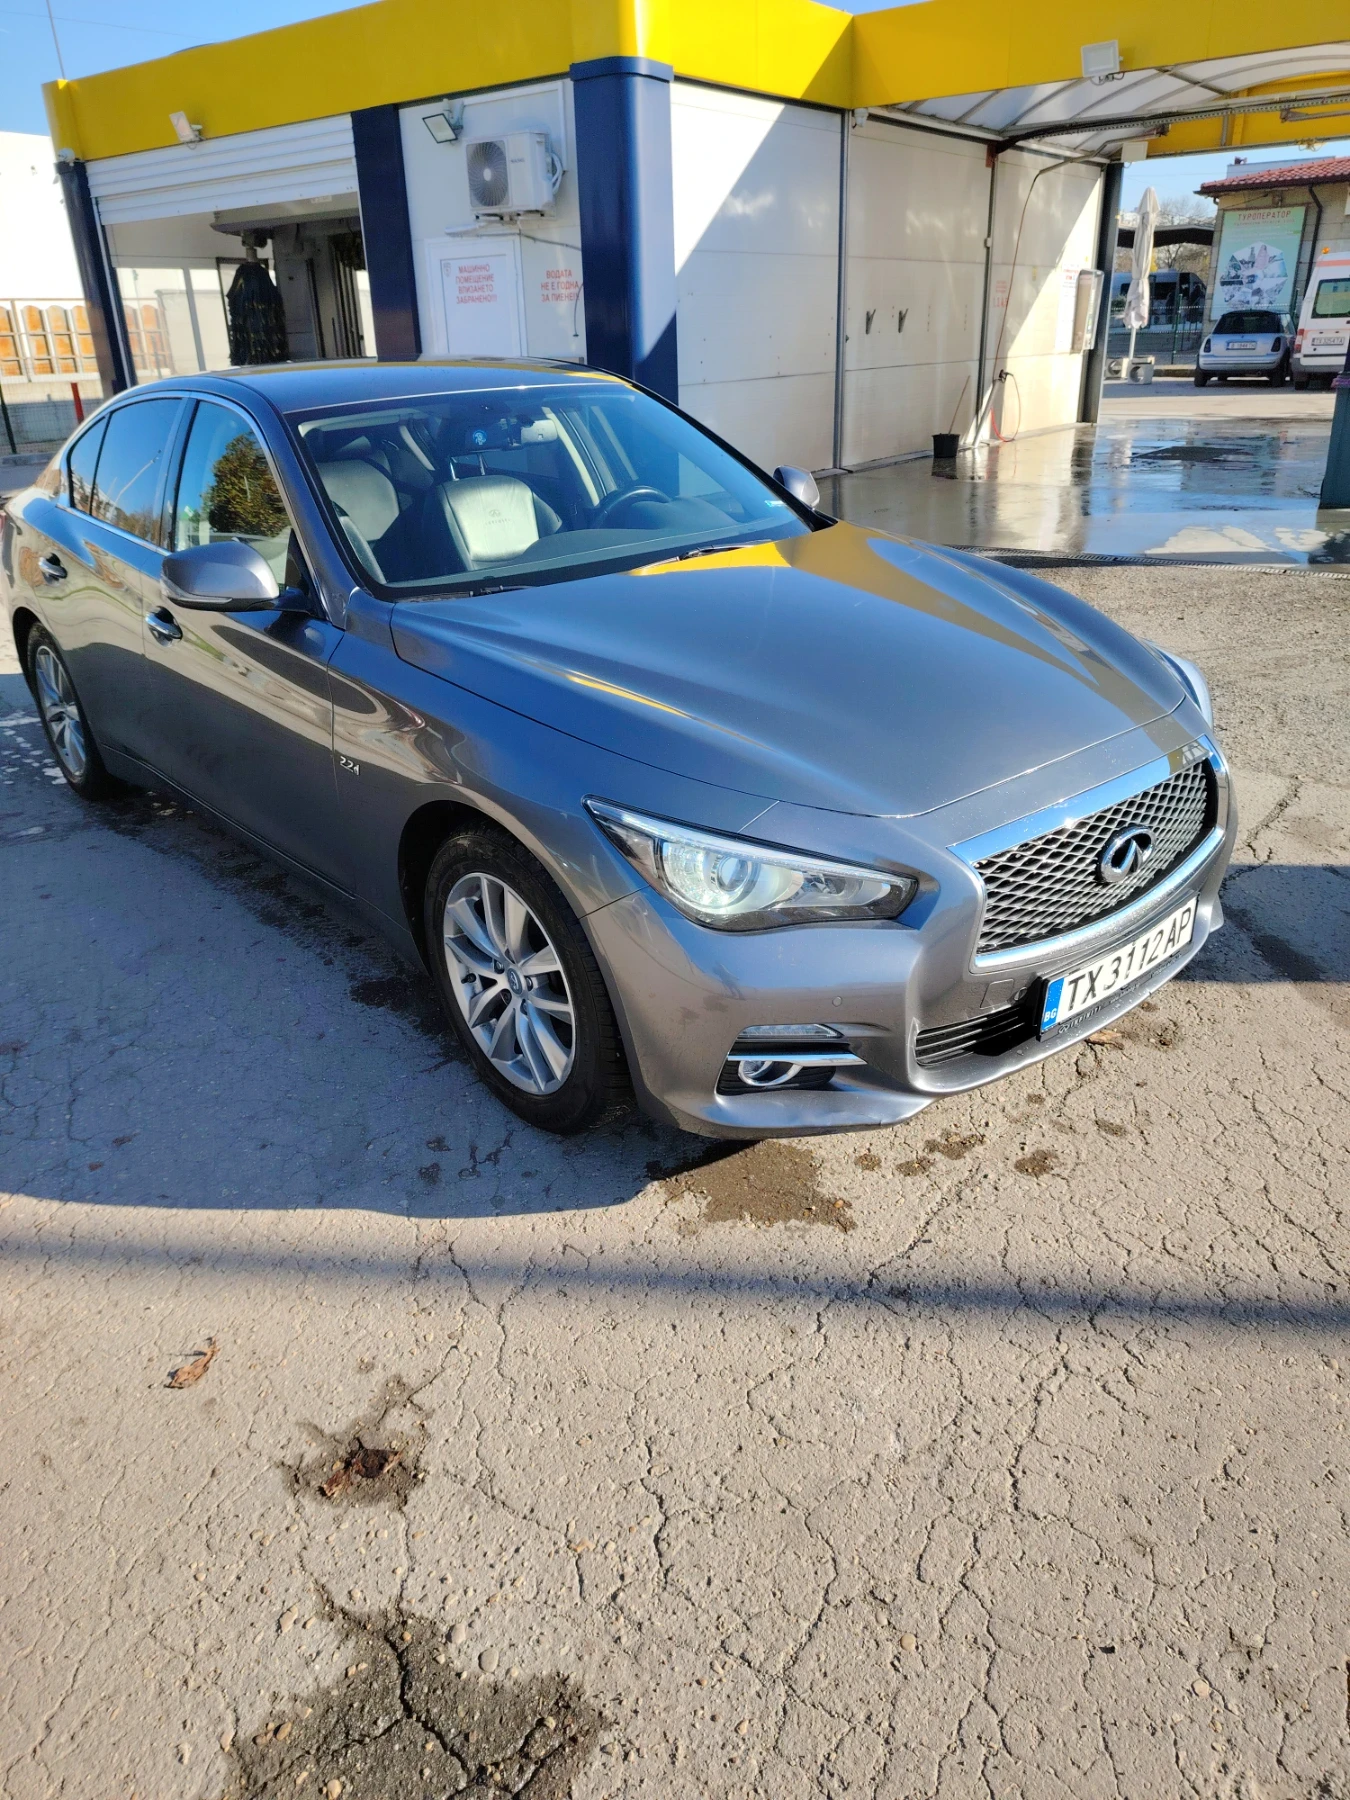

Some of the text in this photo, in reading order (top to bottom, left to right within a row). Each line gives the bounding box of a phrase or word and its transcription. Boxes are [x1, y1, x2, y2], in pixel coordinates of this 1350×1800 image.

[1238, 210, 1291, 220] ТУРОПЕРАТОР
[458, 264, 490, 273] МАШИННО
[455, 274, 494, 284] ПОМЕЩЕНИЕ
[546, 269, 572, 279] ВОДАТА
[458, 284, 493, 294] ВЛИЗАНЕТО
[541, 281, 579, 290] НЕ Е ГОДНА
[541, 293, 549, 302] ЗА
[1044, 1008, 1057, 1022] BG
